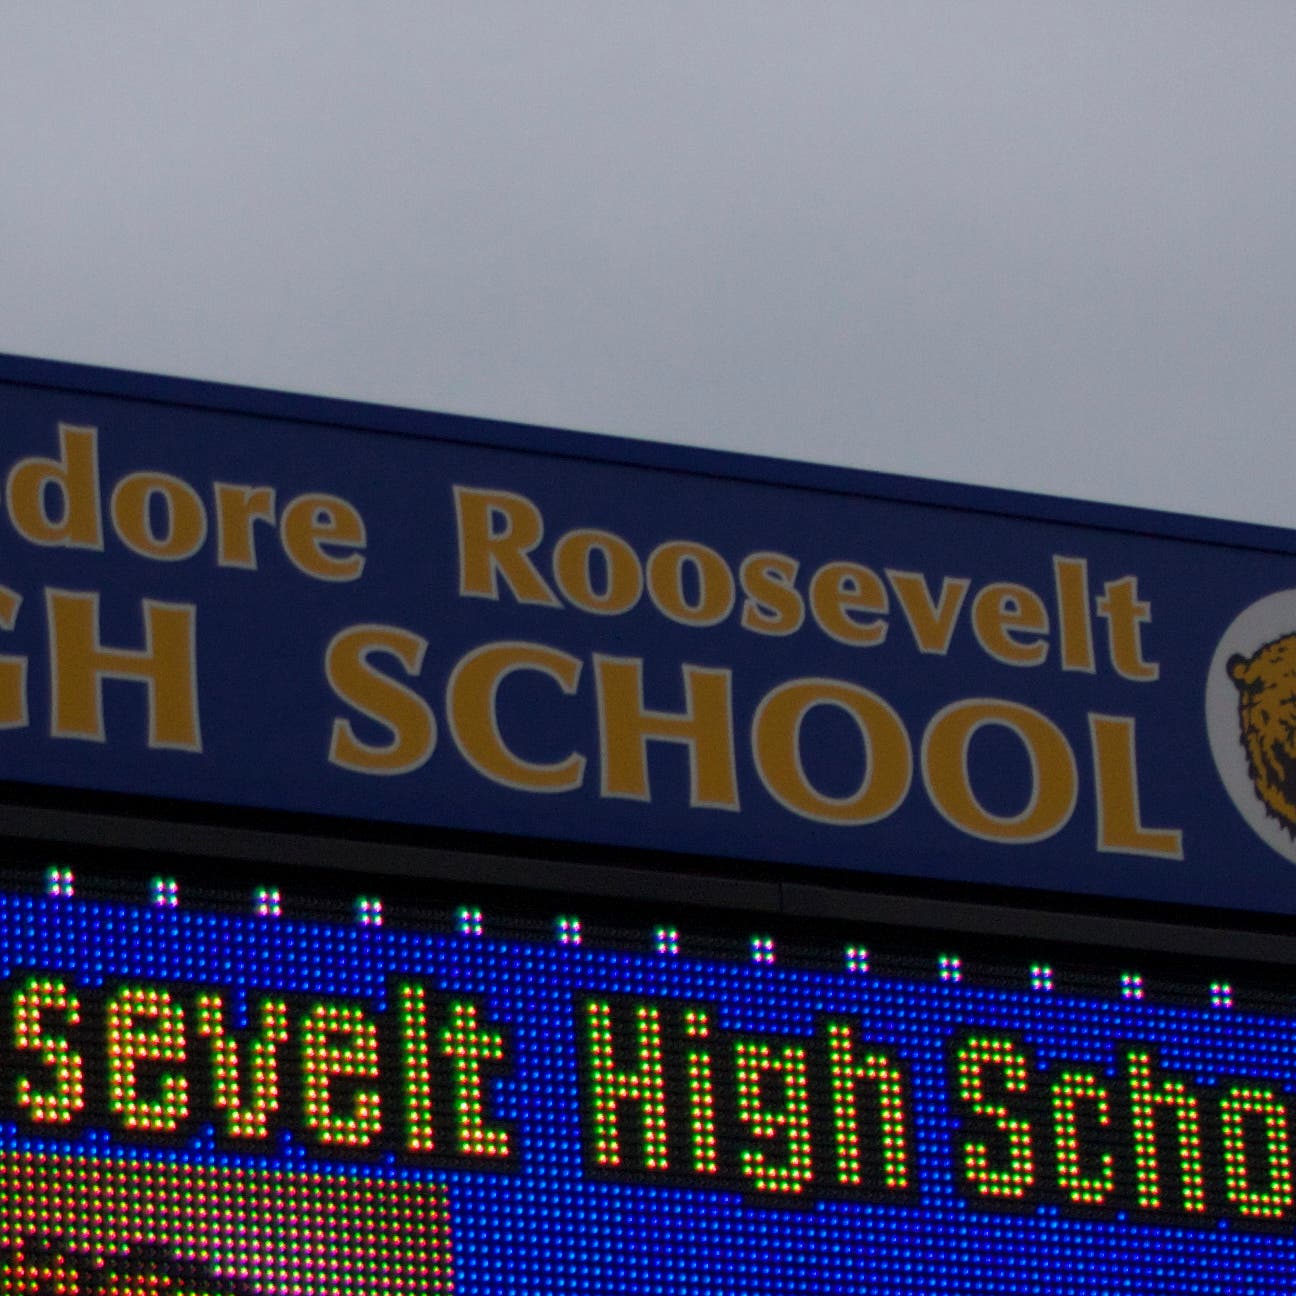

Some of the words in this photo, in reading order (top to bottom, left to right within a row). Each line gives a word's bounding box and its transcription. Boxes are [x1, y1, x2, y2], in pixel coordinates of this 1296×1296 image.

[452, 484, 1159, 681] Roosevelt
[324, 624, 1184, 860] SCHOOL
[587, 1002, 907, 1193] High
